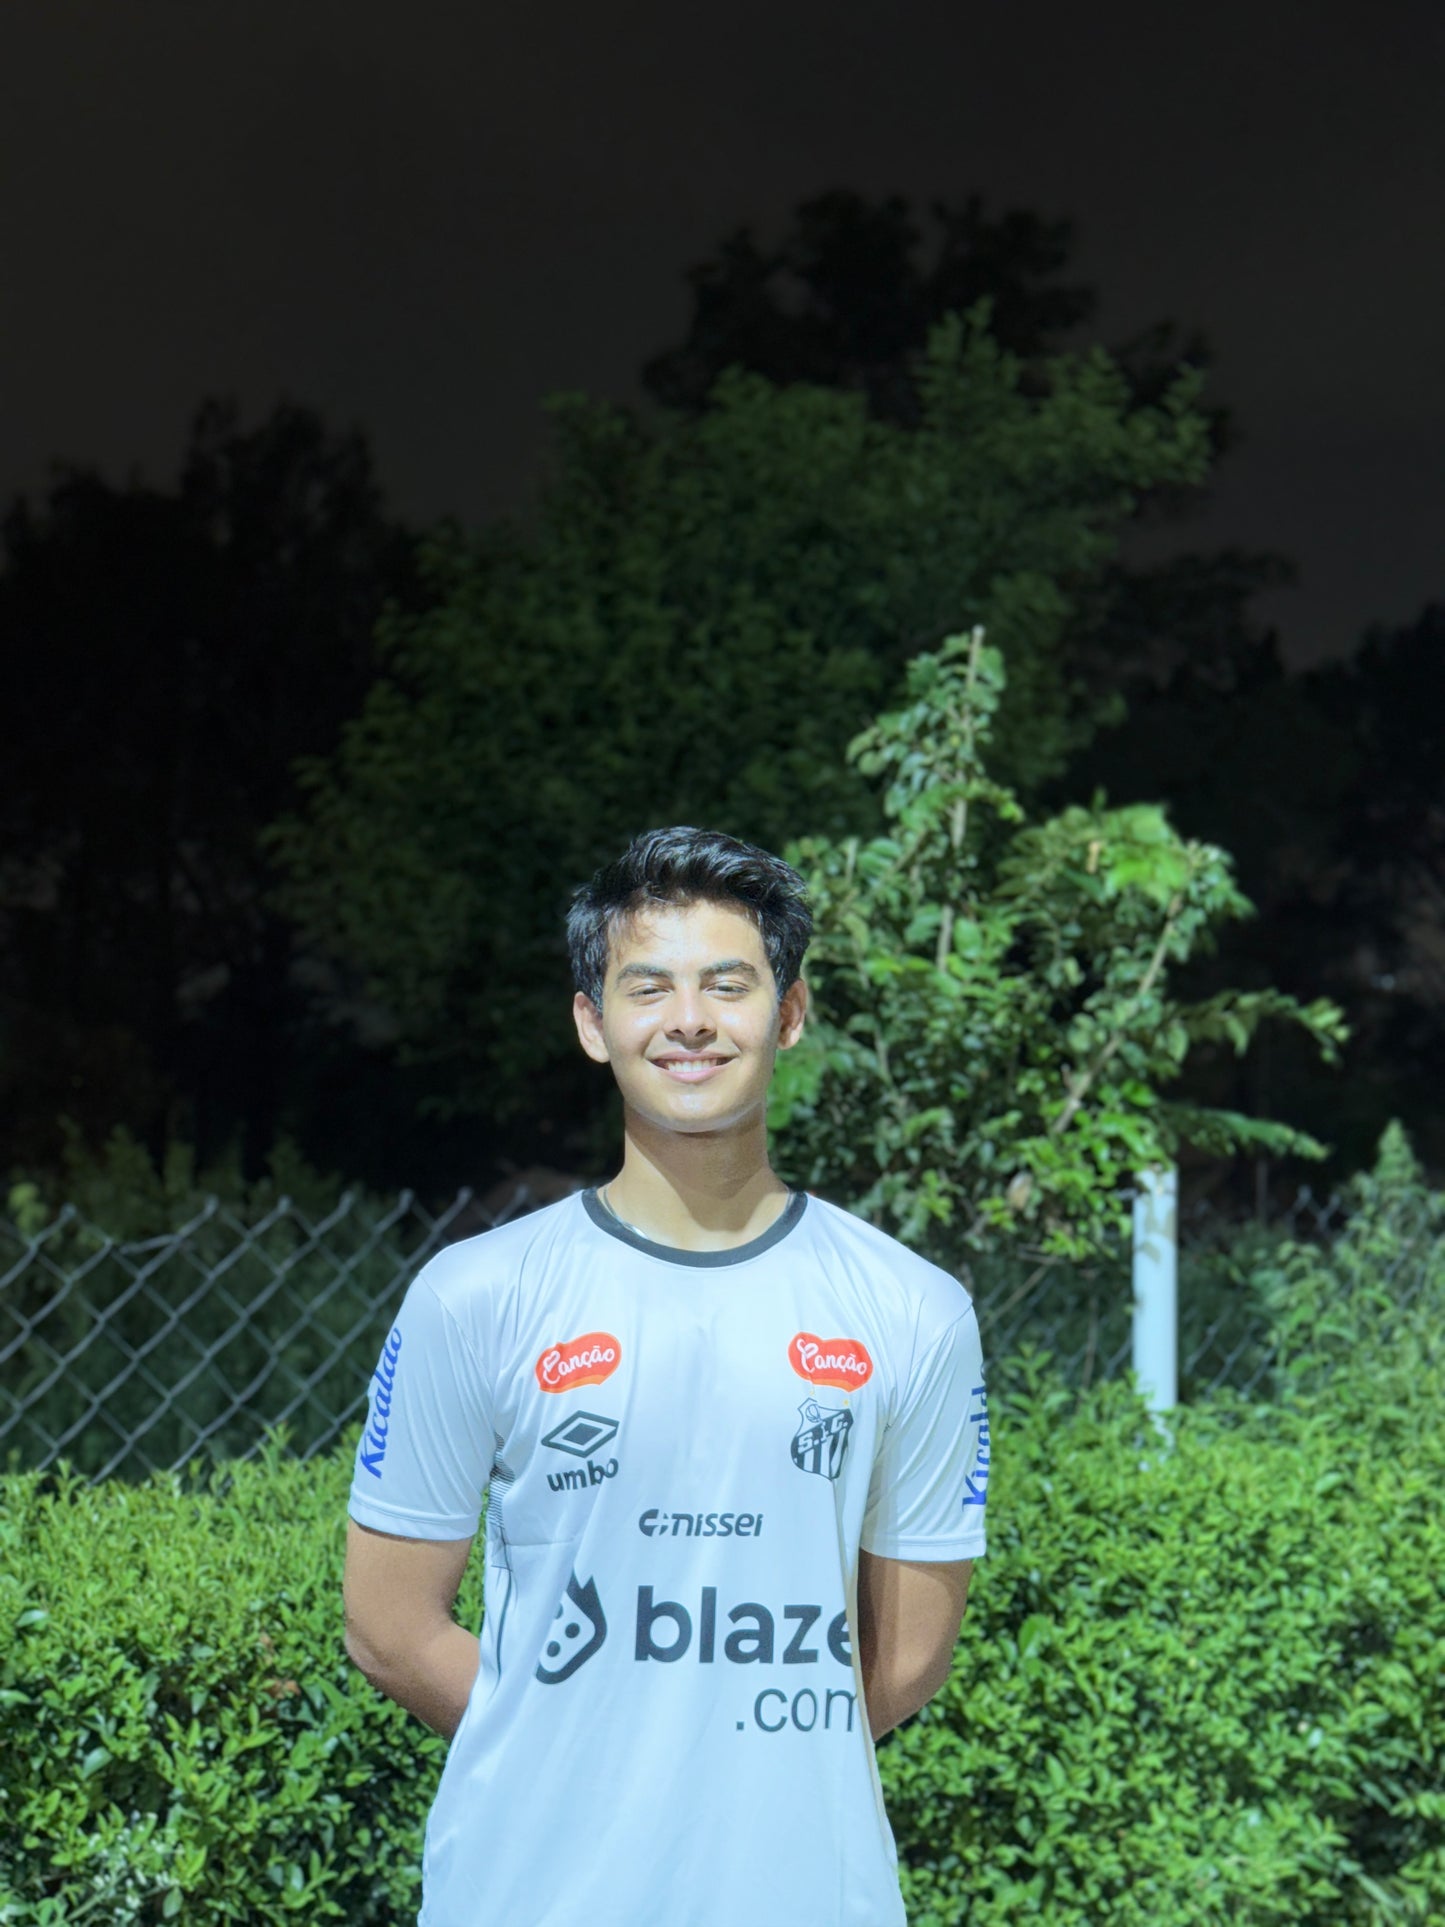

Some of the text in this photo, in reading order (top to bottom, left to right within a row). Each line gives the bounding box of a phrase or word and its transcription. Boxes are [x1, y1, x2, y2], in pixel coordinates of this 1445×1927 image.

[542, 1345, 615, 1384] Canção
[796, 1338, 867, 1375] Canção
[360, 1327, 402, 1479] Kicaldo
[962, 1363, 989, 1511] Kicald
[671, 1512, 764, 1537] nissei
[634, 1585, 854, 1668] blaze
